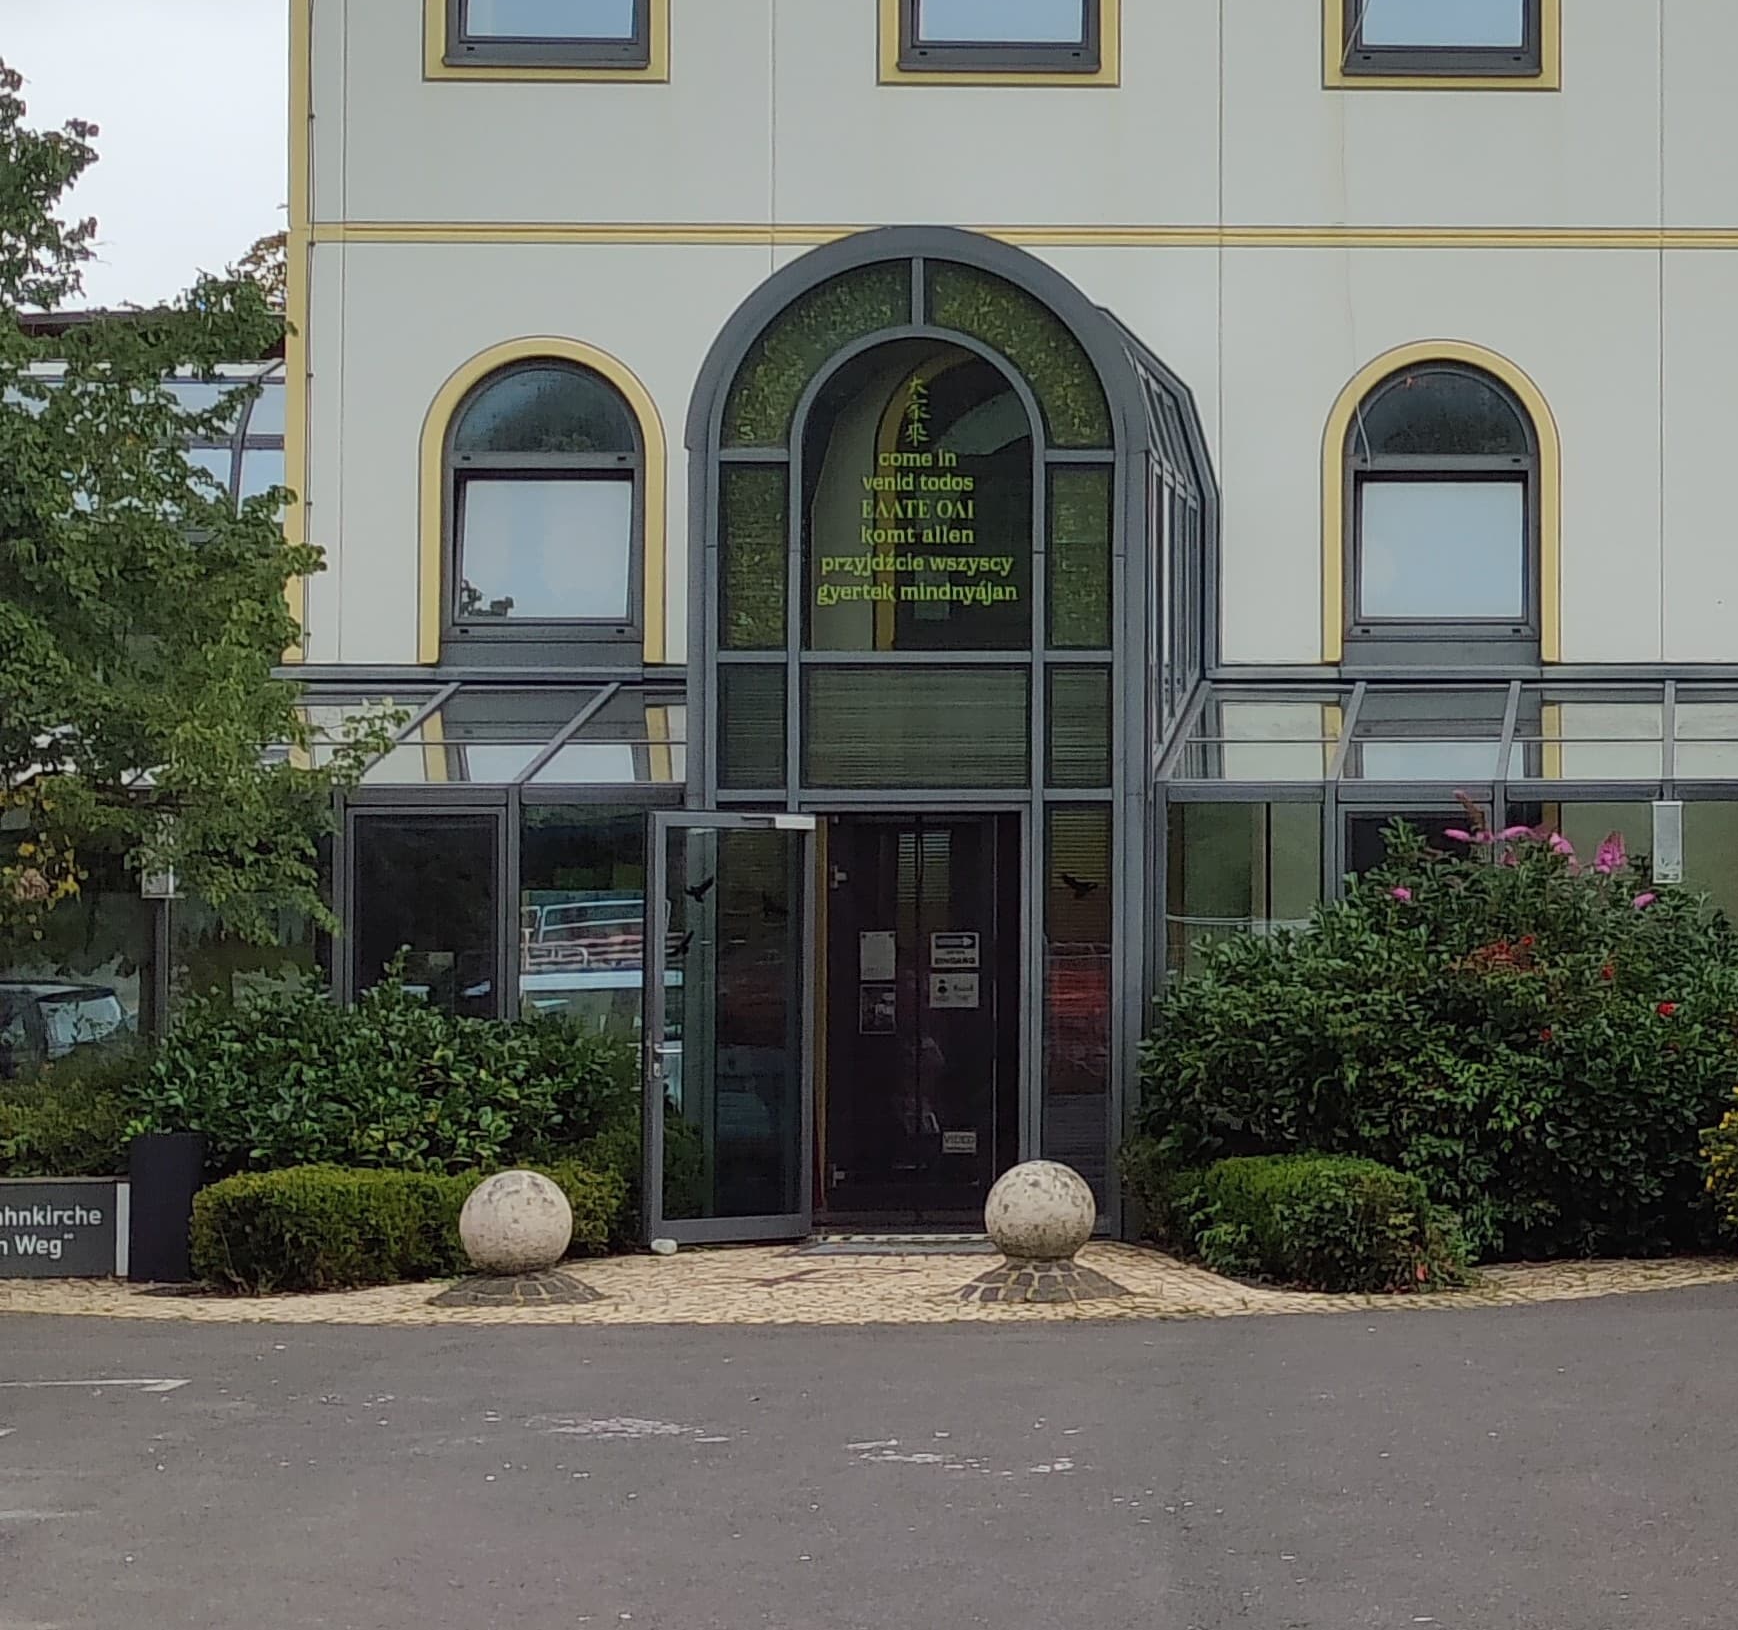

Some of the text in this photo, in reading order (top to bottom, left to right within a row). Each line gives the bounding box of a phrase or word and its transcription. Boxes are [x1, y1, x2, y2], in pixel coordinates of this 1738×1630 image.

[879, 449, 957, 467] come in
[863, 472, 974, 491] venid todos
[861, 525, 975, 545] komt allen
[821, 551, 1014, 576] przyjdźcie wszyscy
[816, 580, 1019, 605] gyertek mindnyájan
